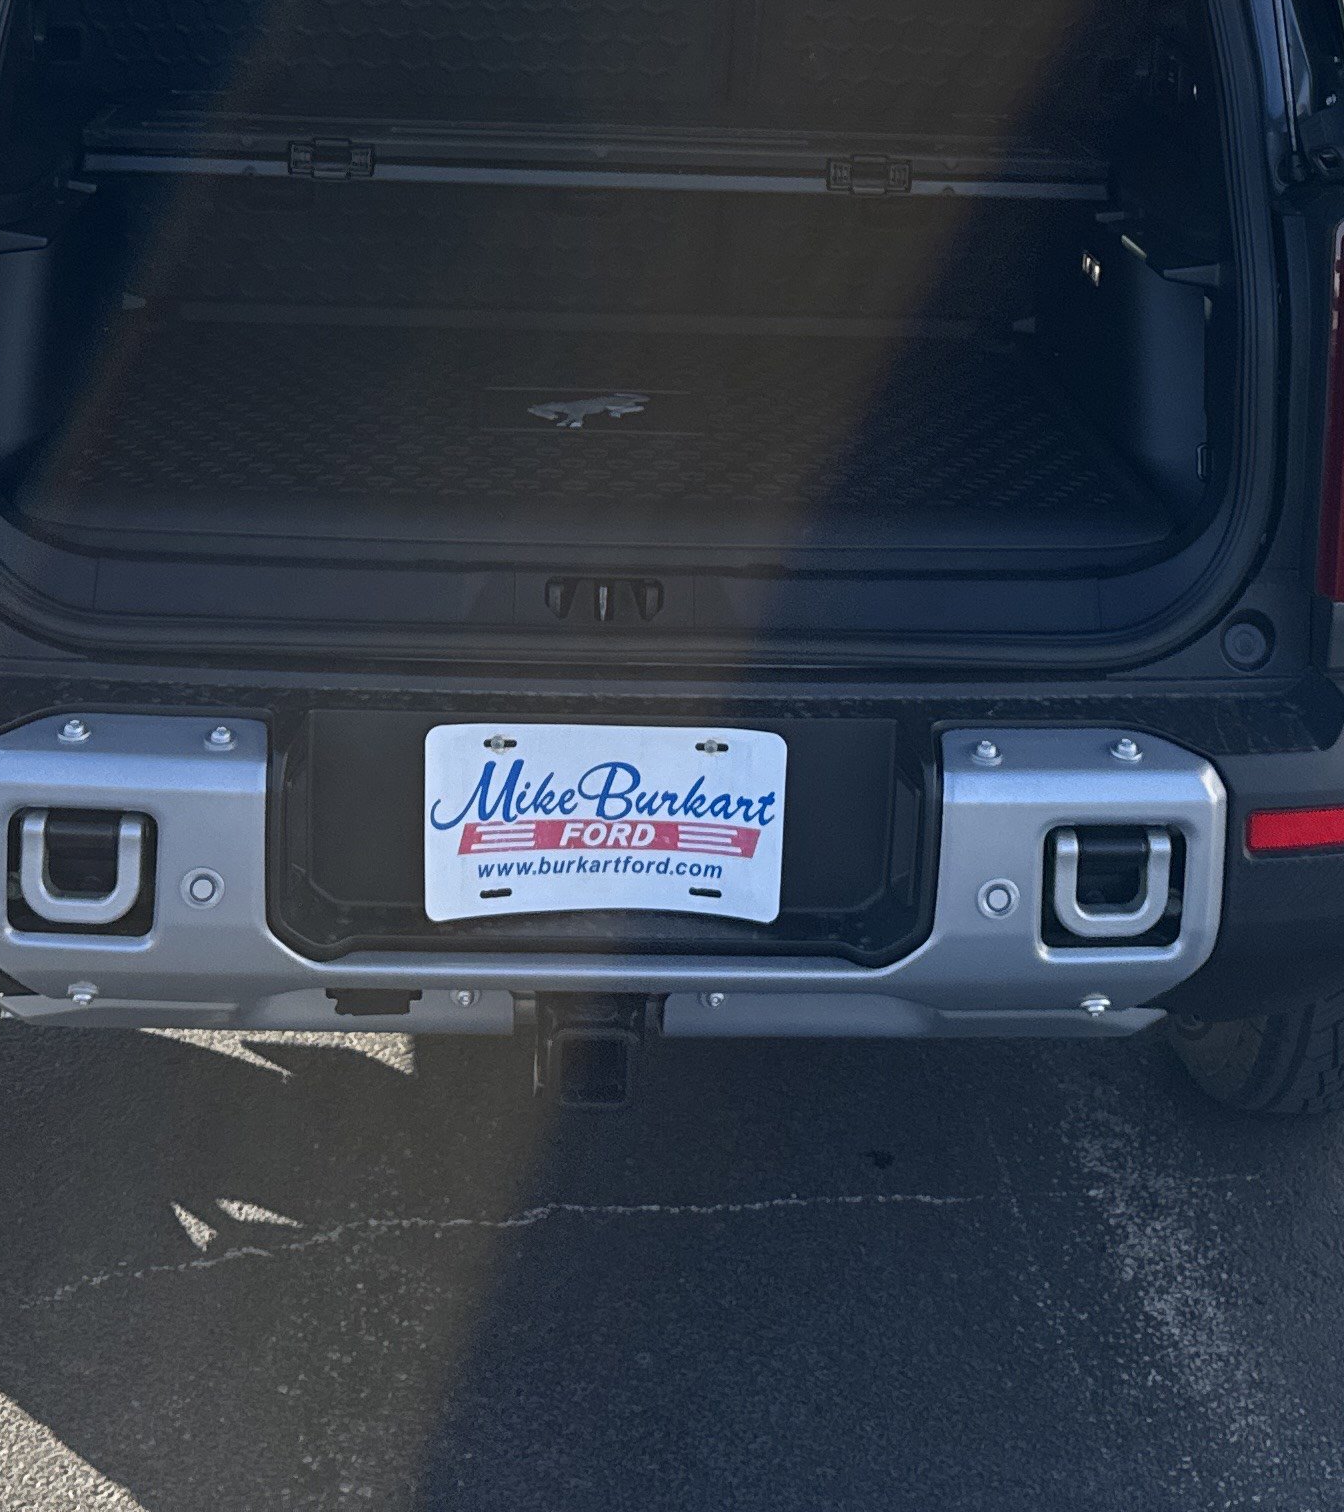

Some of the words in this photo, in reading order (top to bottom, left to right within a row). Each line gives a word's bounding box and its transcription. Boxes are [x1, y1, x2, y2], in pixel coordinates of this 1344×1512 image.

[430, 758, 578, 830] Mike
[578, 761, 776, 826] Burkart
[558, 822, 657, 848] FORD
[476, 854, 724, 879] www.burkartford.com
